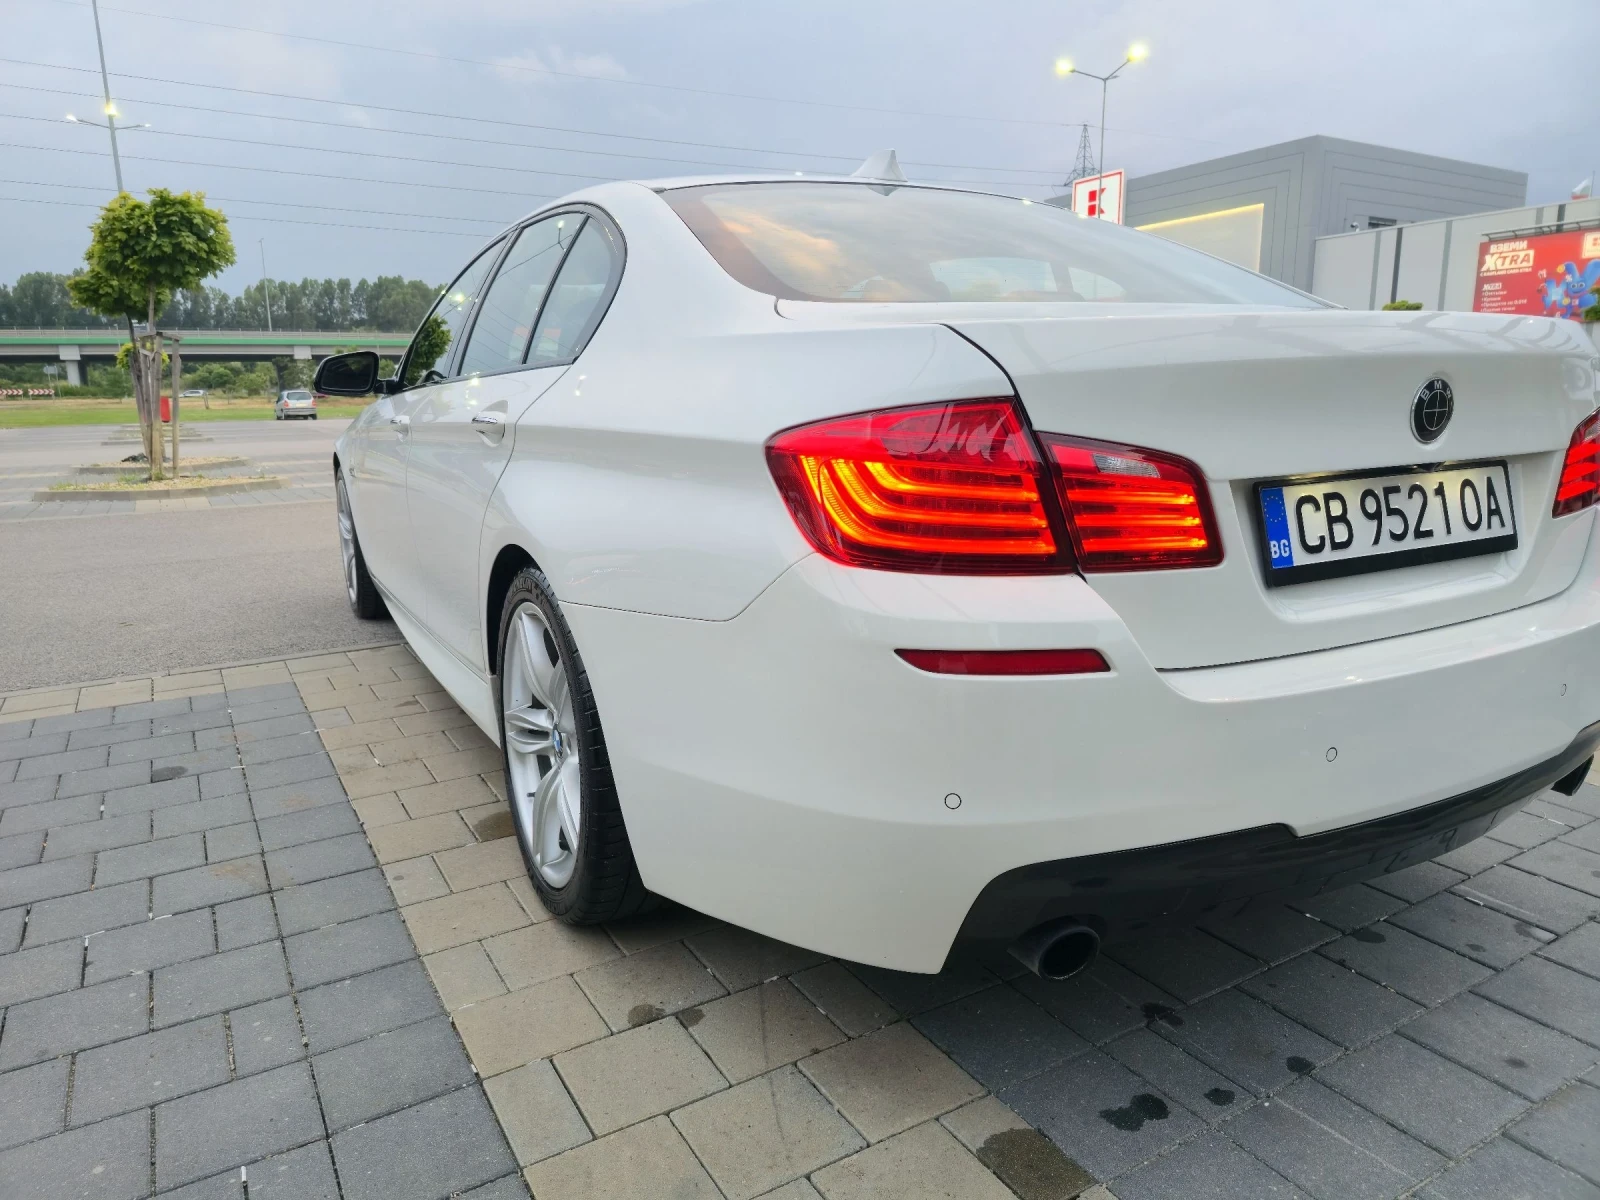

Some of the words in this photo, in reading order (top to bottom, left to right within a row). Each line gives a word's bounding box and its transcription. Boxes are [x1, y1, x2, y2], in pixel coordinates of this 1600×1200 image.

[1490, 240, 1528, 253] ВЗЕМИ
[1481, 251, 1532, 271] XTRA
[1420, 380, 1452, 401] BMW
[1295, 491, 1354, 555] CB
[1359, 480, 1452, 547] 9521
[1459, 475, 1506, 532] OA
[1270, 538, 1290, 559] BG
